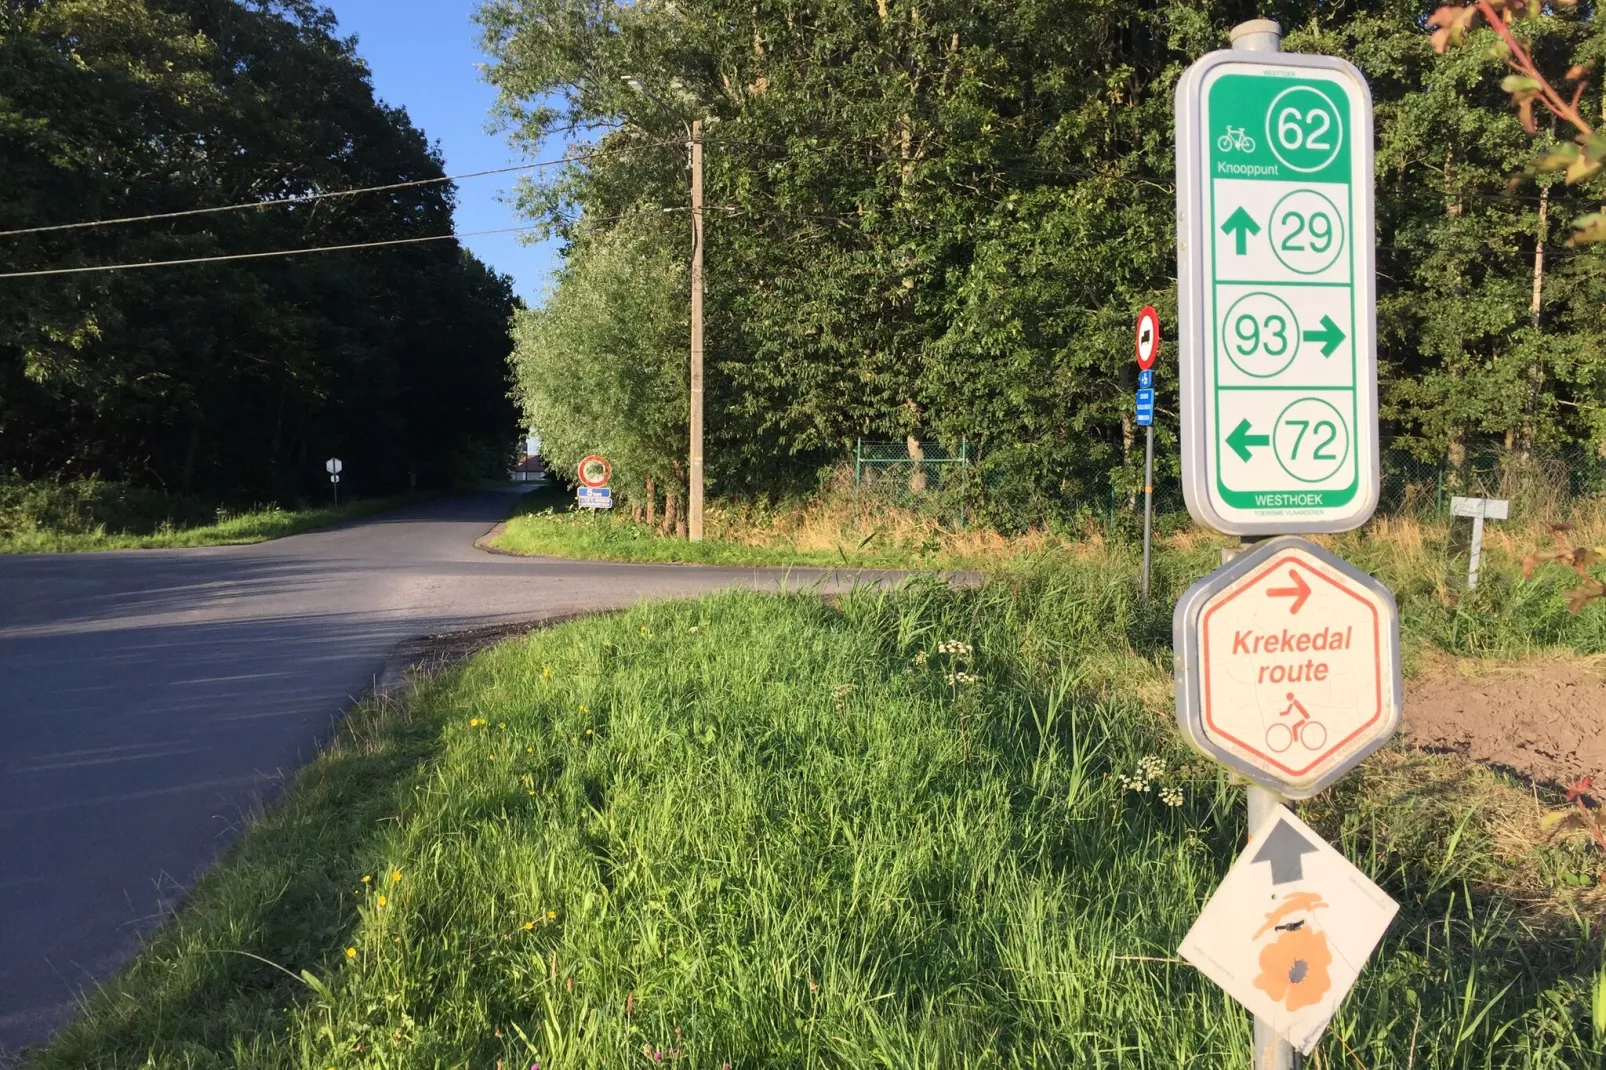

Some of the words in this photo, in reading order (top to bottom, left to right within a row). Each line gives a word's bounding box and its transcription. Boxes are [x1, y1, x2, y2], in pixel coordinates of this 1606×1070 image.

[1278, 107, 1330, 150] 62
[1217, 161, 1279, 176] Knooppunt
[1281, 211, 1333, 253] 29
[1235, 313, 1288, 356] 93
[1285, 420, 1337, 460] 72
[1255, 494, 1324, 506] WESTHOEK
[1232, 625, 1353, 655] Krekedal
[1258, 659, 1329, 684] route
